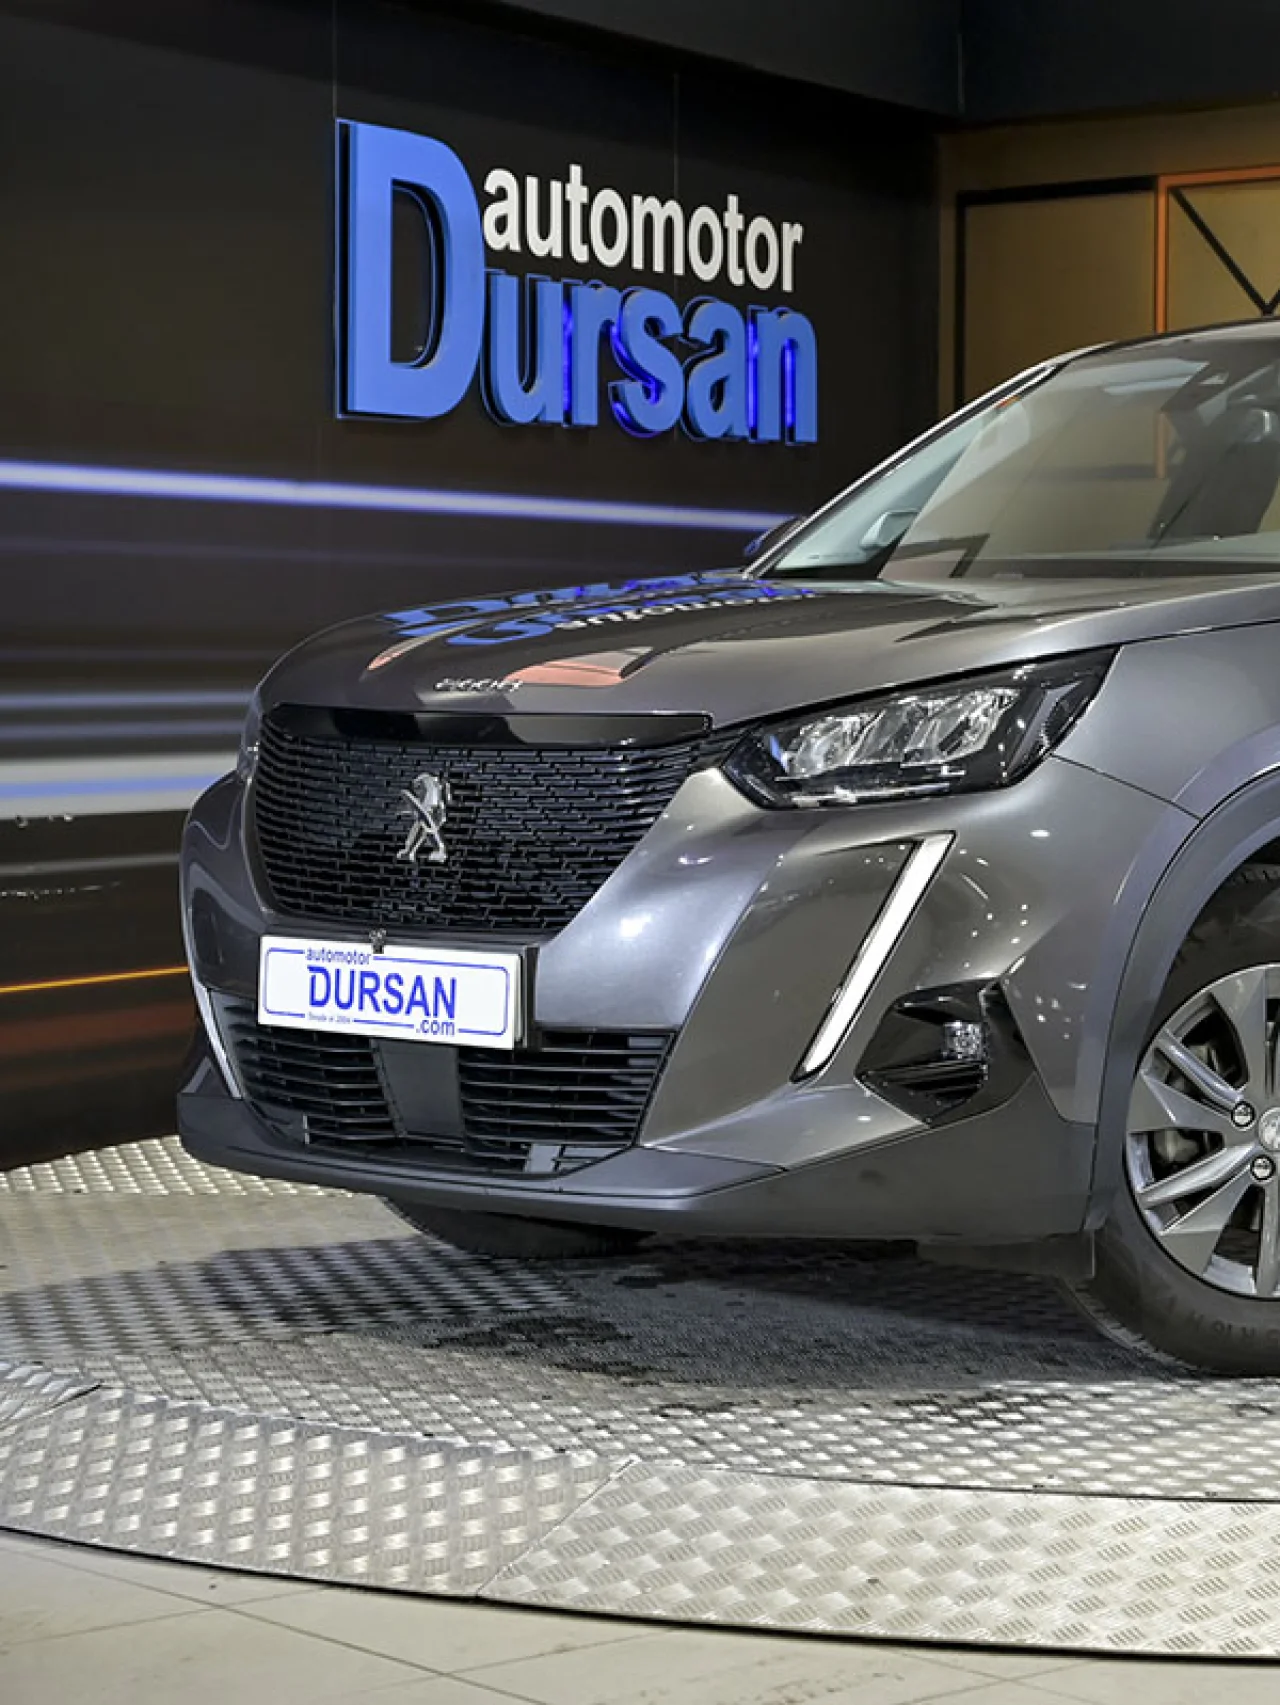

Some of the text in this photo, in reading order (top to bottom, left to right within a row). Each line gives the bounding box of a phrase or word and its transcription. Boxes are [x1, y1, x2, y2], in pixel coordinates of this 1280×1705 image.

[482, 164, 803, 292] automotor
[336, 118, 818, 444] Dursan
[305, 948, 371, 965] automotor
[307, 964, 457, 1019] DURSAN
[416, 1019, 455, 1036] .com
